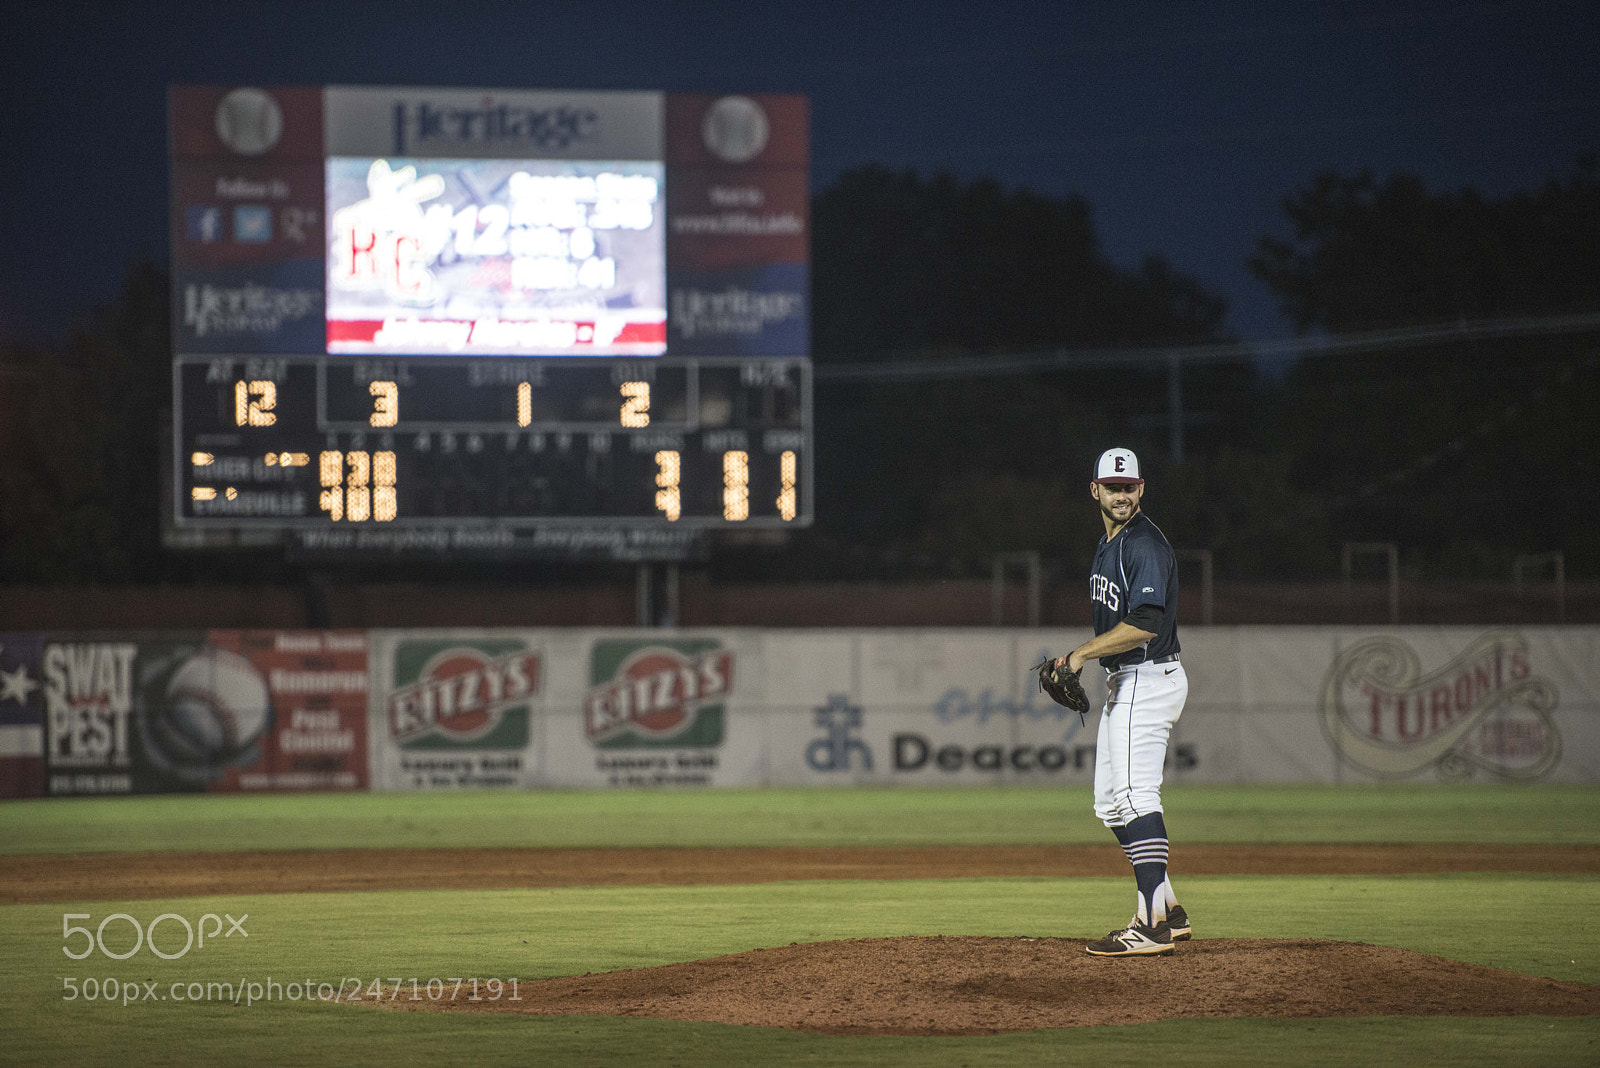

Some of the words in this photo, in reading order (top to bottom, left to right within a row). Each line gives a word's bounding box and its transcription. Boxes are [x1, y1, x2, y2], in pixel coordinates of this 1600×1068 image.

[393, 101, 598, 155] Heritage
[245, 358, 288, 382] BAT
[353, 360, 412, 386] BALL
[235, 380, 277, 427] 12
[368, 380, 398, 428] 3
[517, 381, 532, 428] 1
[620, 381, 650, 428] 2
[1114, 456, 1126, 473] E
[1089, 574, 1121, 612] TERS
[44, 642, 138, 711] SWAT
[47, 697, 130, 758] PEST
[892, 732, 1198, 774] Deacons
